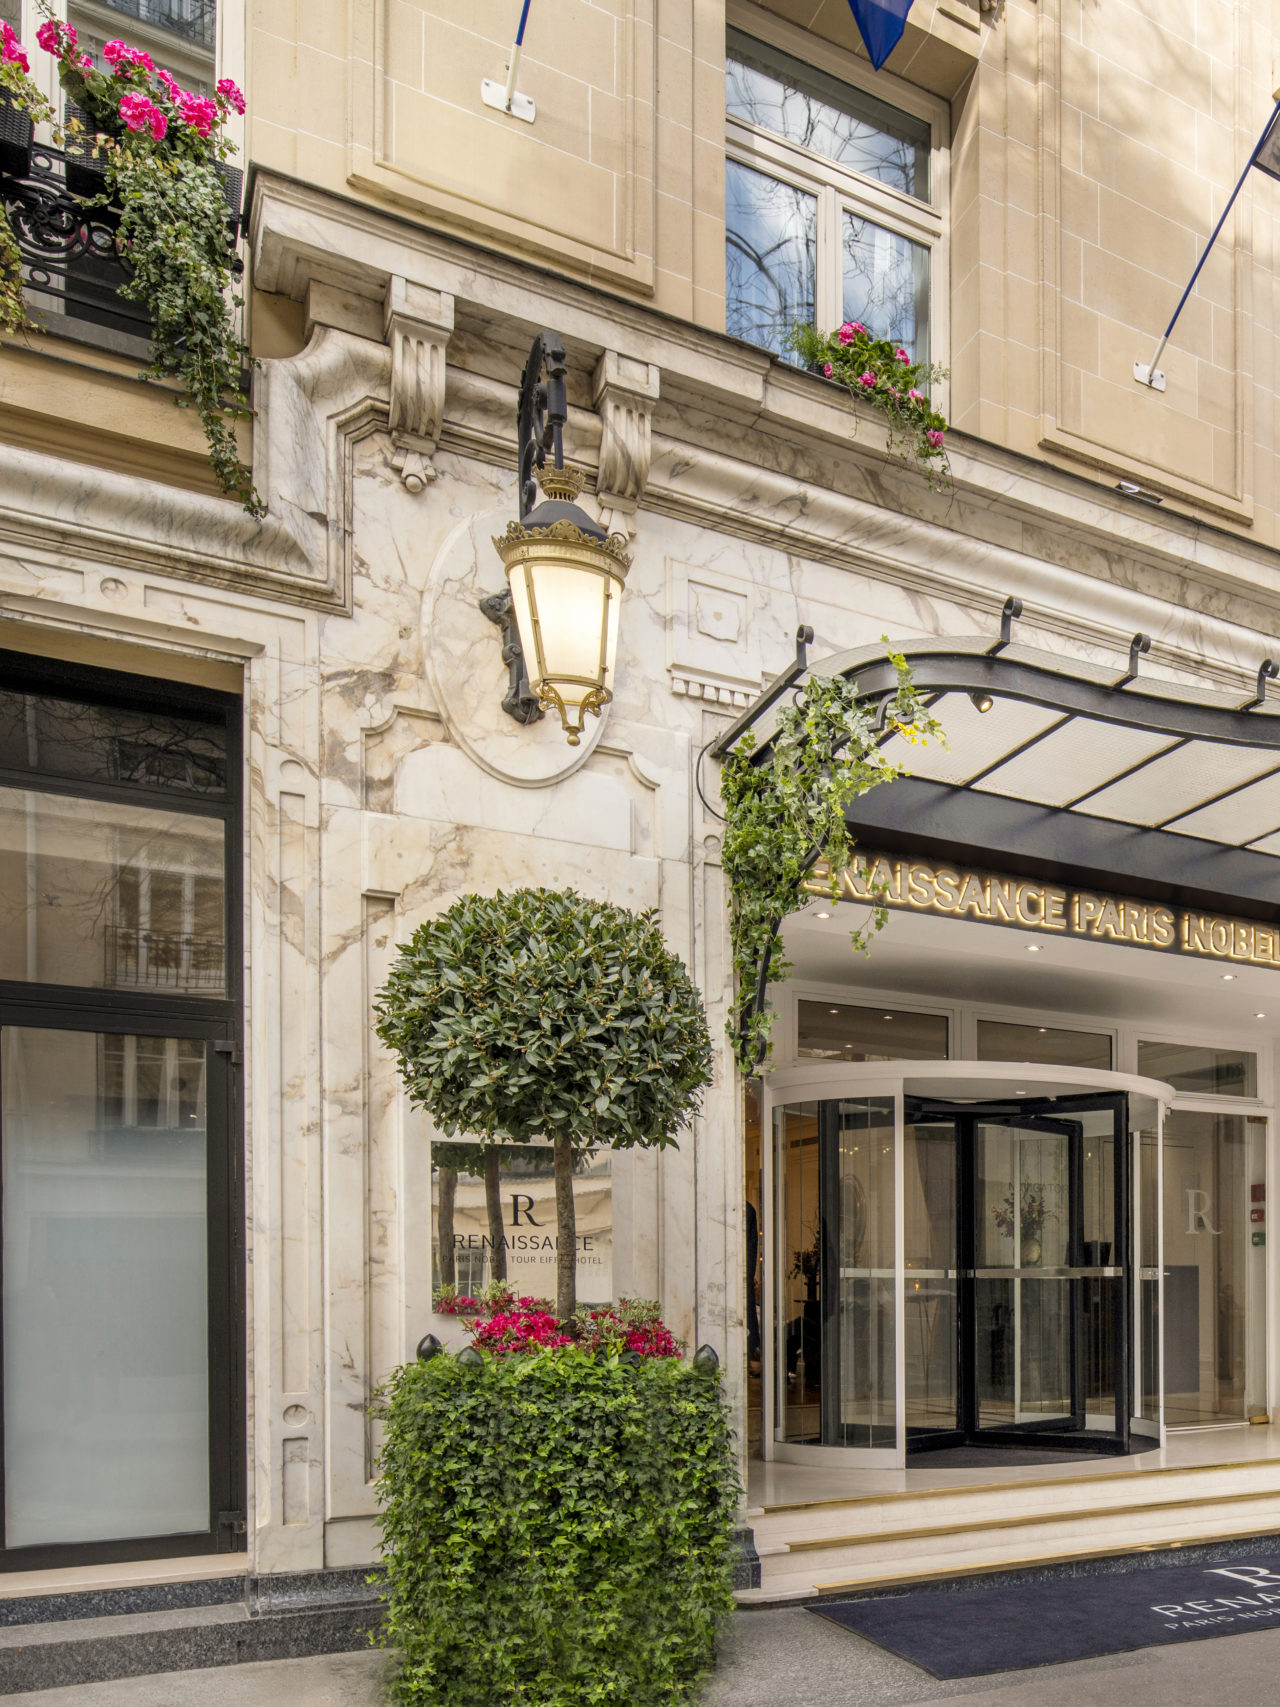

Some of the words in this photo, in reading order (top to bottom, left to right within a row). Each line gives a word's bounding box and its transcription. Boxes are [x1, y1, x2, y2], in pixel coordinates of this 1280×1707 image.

[1075, 894, 1176, 944] PARIS
[510, 1194, 546, 1227] R
[1185, 1189, 1224, 1235] R
[453, 1234, 594, 1251] RENAISSAE
[511, 1256, 536, 1264] TOUR
[1164, 1615, 1235, 1630] PARIS
